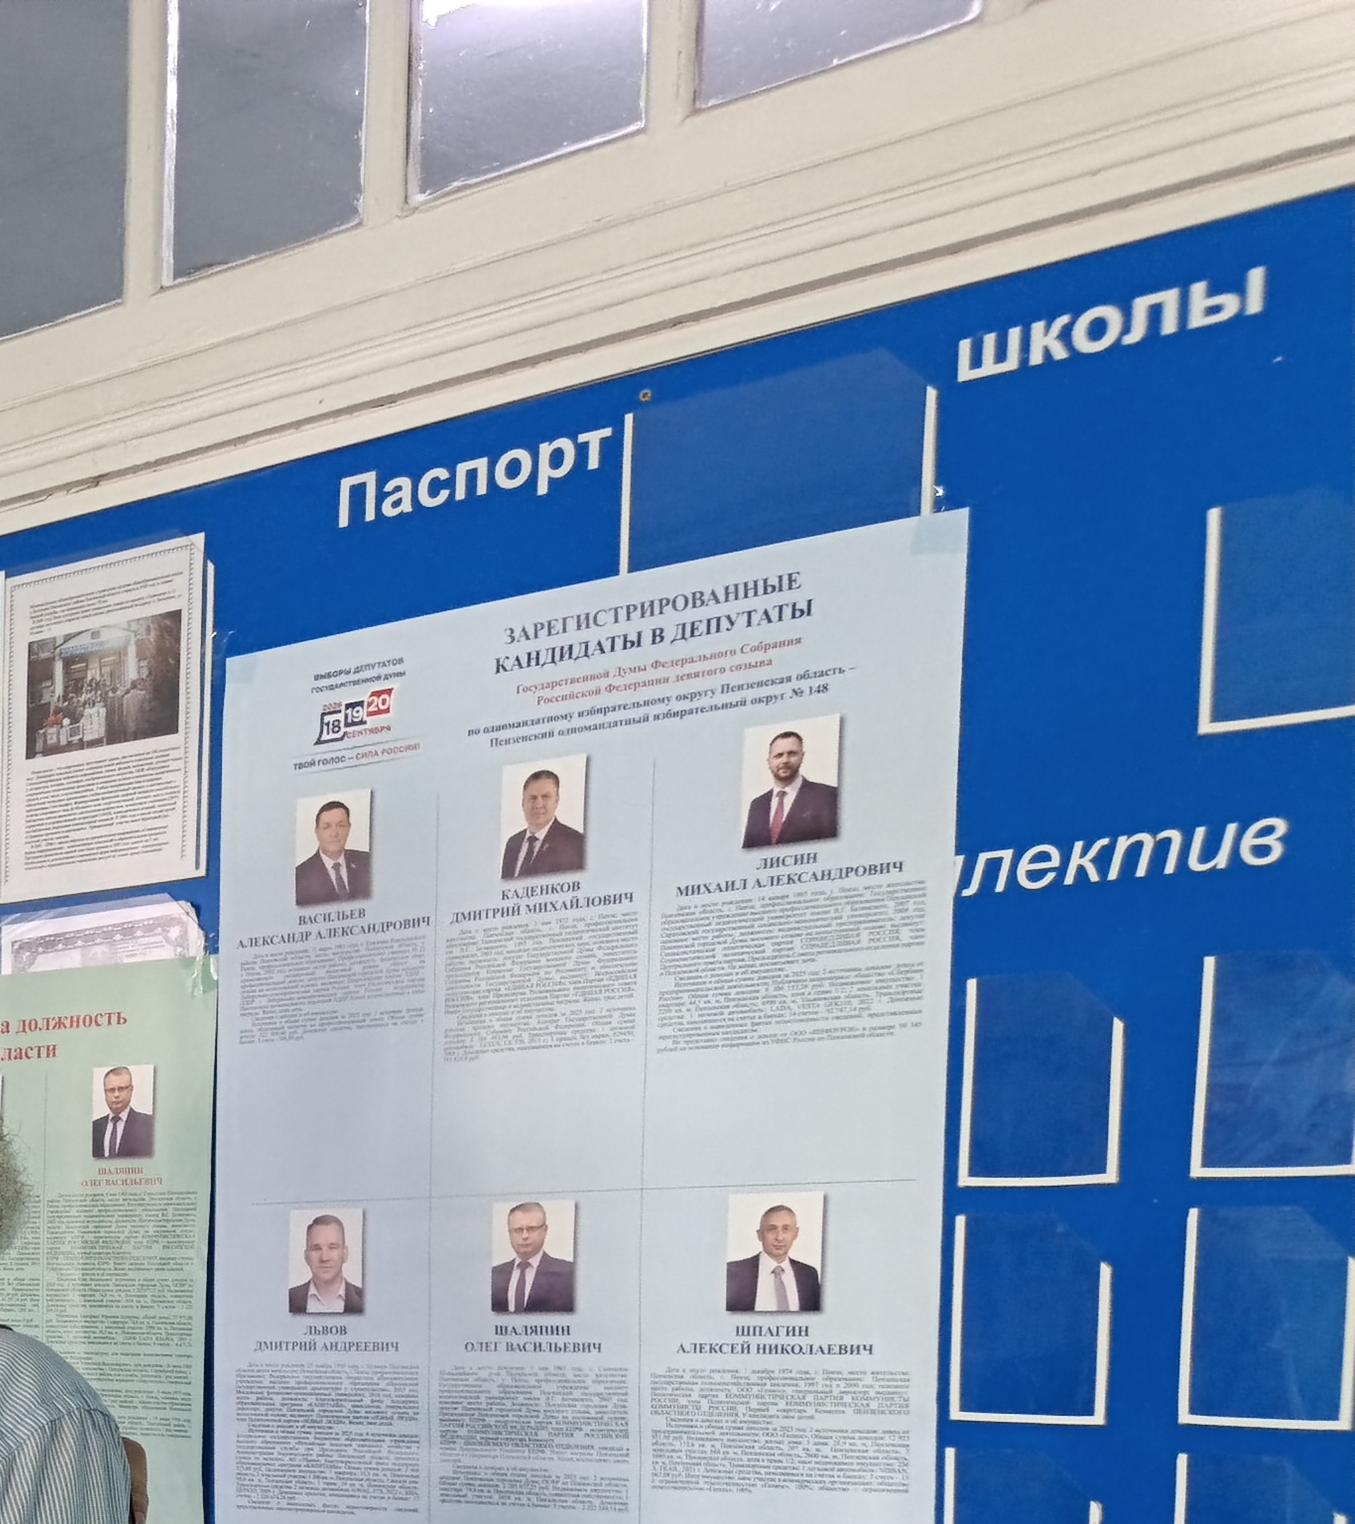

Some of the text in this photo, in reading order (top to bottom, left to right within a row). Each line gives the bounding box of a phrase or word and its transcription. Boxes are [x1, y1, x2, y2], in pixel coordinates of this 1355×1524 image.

[338, 265, 1267, 528] Паспорт школы
[503, 571, 802, 645] ЗАРЕГИСТРИРОВАННЫЕ
[494, 598, 814, 674] КАНДИДАТЫ В ДЕПУТАТЫ
[314, 657, 404, 681] ВЫБОРЫ ДЕПУТАТОВ
[516, 636, 802, 695] Государственной Думы Федерального Собрания
[536, 657, 773, 706] Российской Федерации девятого созыва
[324, 694, 390, 735] 18 19 20
[467, 665, 846, 738] по одномандатному избирательному округу Пензенская область
[490, 726, 555, 748] Пензенский
[557, 711, 650, 737] одномандатный
[653, 696, 747, 721] избирательный
[750, 692, 787, 708] округ
[808, 682, 829, 695] 148
[293, 758, 316, 771] ТВОЙ
[317, 755, 346, 767] ГОЛОС
[756, 852, 818, 871] ЛИСИН
[953, 816, 1289, 897] лектив
[501, 880, 581, 901] КАДЕНКОВ
[675, 860, 905, 898] МИХАИЛ АЛЕКСАНДРОВИЧ
[298, 907, 366, 926] ВАСИЛЬЕВ
[449, 891, 634, 925] ДМИТРИЙ МИХАЙЛОВИЧ
[236, 915, 431, 949] АЛЕКСАНДР АЛЕКСАНДРОВИЧ
[15, 1011, 128, 1036] должность
[253, 1338, 400, 1352] ДМИТРИЙ АНДРЕЕВИЧ
[303, 1325, 348, 1336] ЛЬВОВ
[494, 1325, 571, 1336] ШАЛЯПИН
[735, 1325, 810, 1338] ШПАГИН
[464, 1341, 602, 1354] ОЛЕГ ВАСИЛЬЕВИЧ
[676, 1339, 874, 1356] АЛЕКСЕЙ НИКОЛАЕВИЧ
